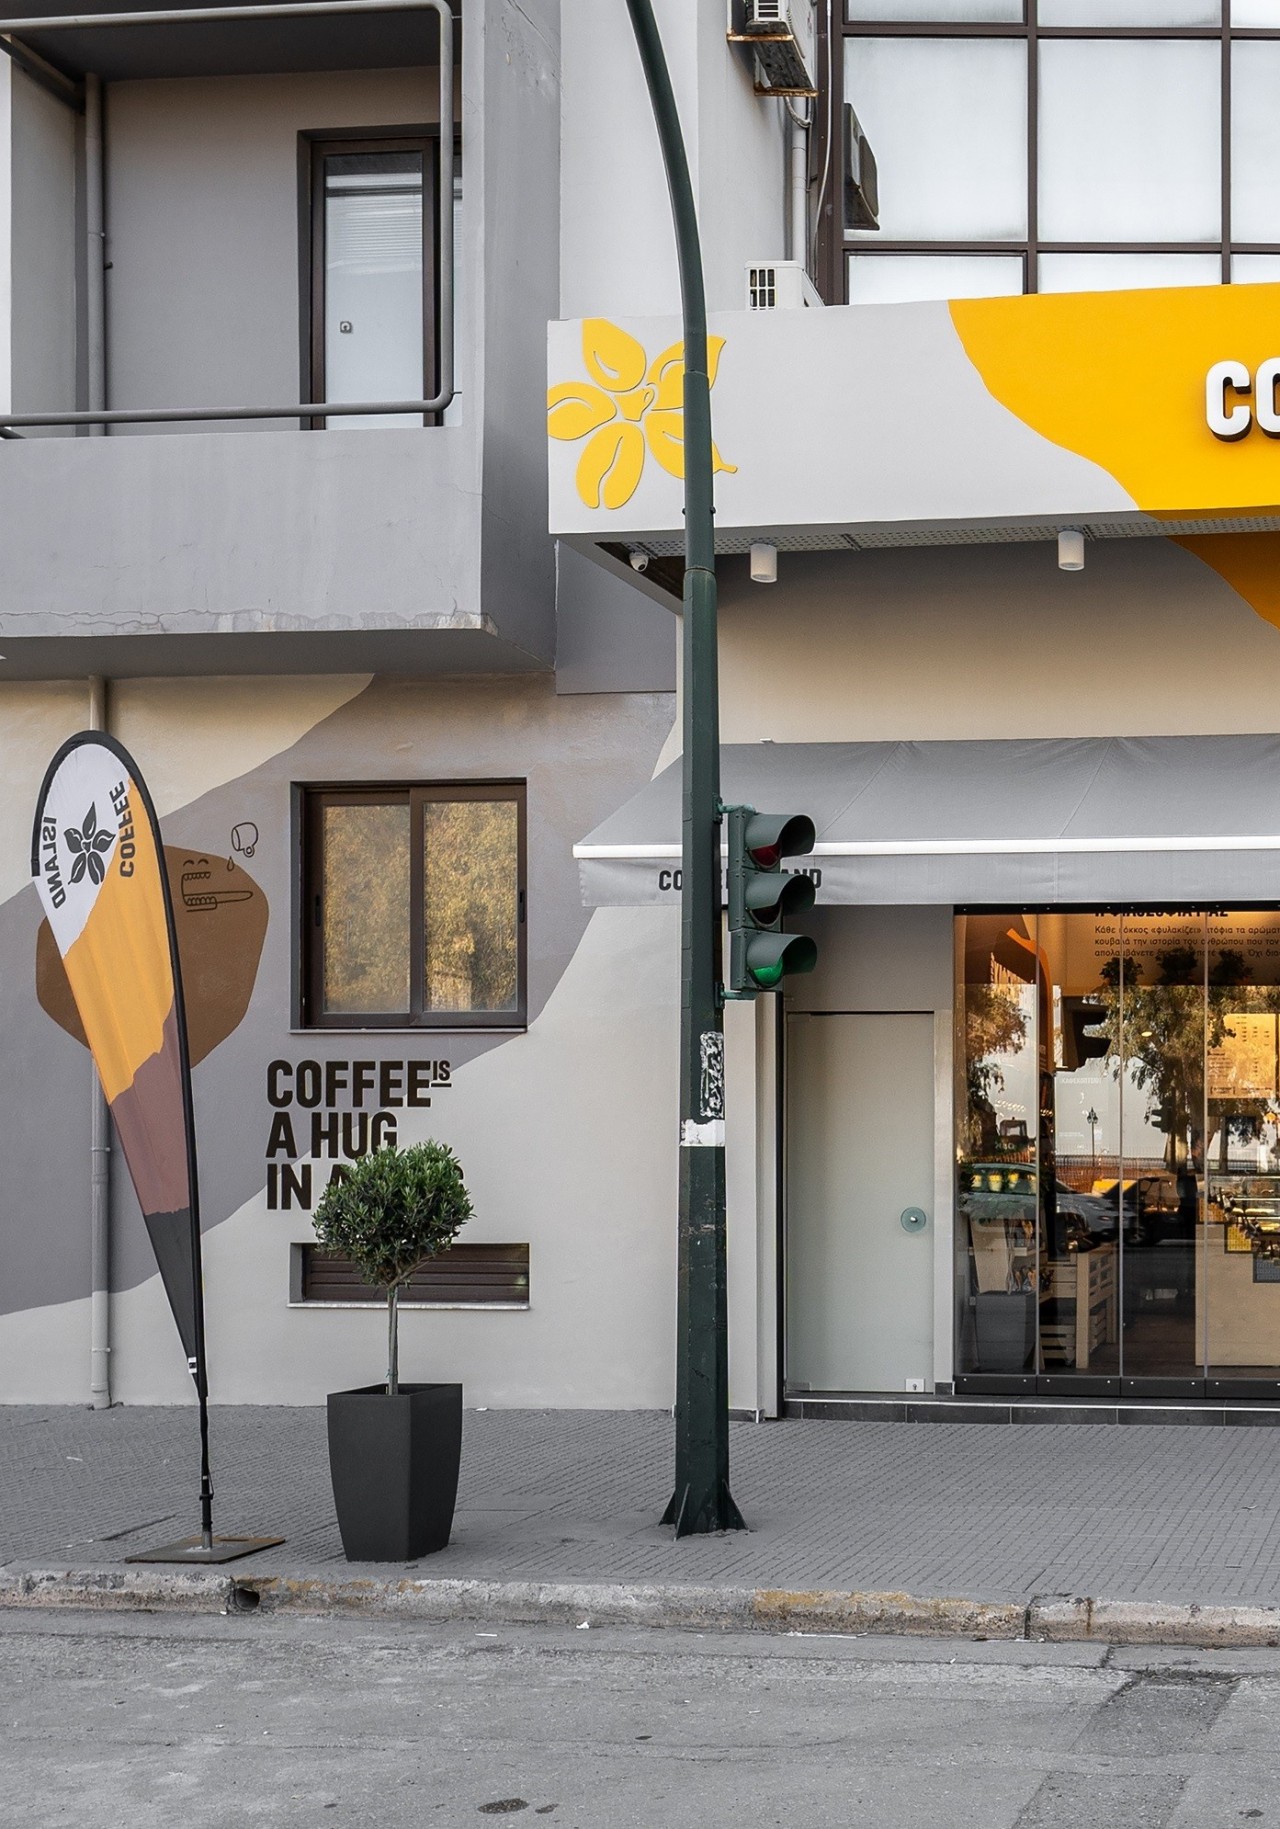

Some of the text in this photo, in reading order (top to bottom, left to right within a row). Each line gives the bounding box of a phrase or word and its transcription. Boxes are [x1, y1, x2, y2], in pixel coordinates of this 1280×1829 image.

[1094, 925, 1116, 934] Κάθε
[1119, 926, 1149, 935] όκκος
[267, 1060, 450, 1108] COFFEE IS
[266, 1111, 397, 1160] A HUG
[267, 1163, 312, 1210] IN
